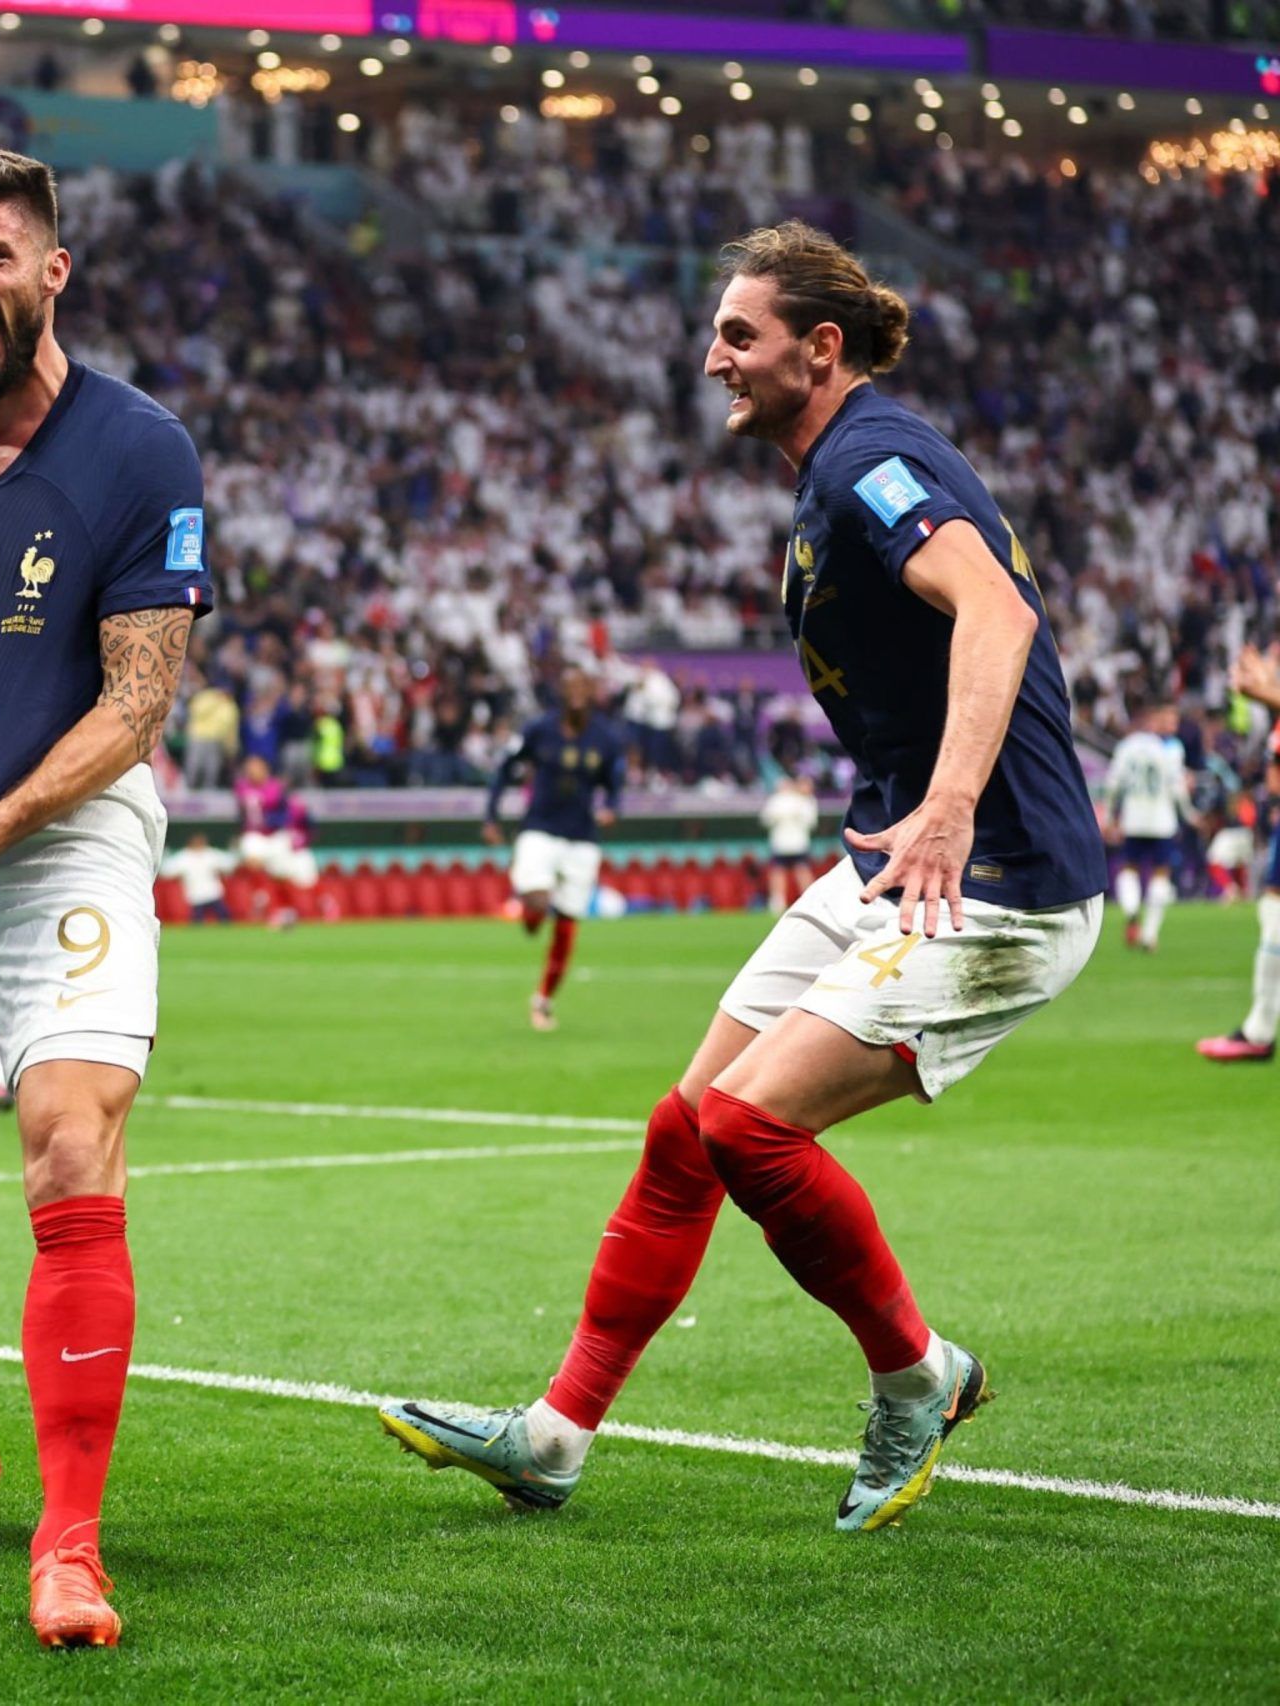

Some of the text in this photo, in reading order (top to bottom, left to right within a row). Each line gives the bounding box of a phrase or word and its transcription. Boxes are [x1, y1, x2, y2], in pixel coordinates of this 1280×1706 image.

[800, 634, 849, 697] 4
[57, 906, 111, 979] 9
[857, 931, 923, 989] 4
